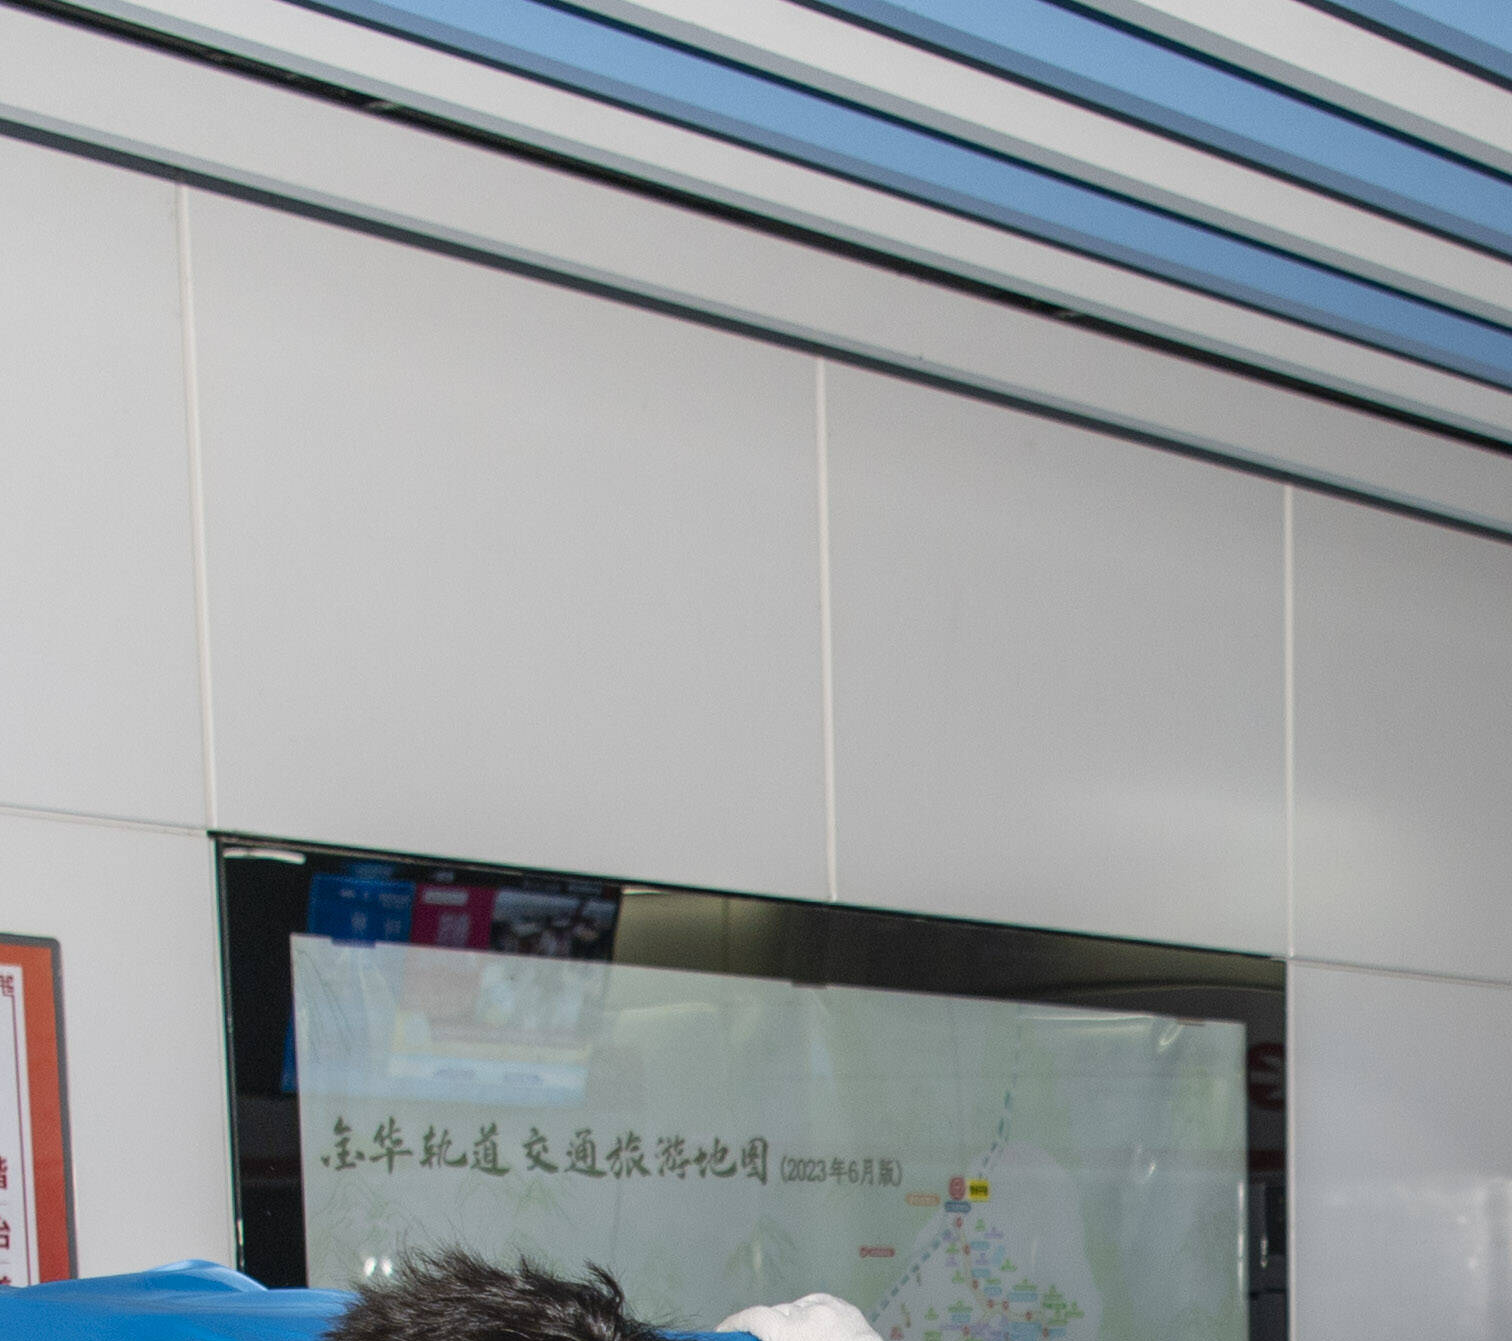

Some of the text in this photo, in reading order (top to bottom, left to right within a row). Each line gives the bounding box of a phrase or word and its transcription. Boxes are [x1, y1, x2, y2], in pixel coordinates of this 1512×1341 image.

[320, 1116, 769, 1185] 金华轨道交通旅游地图
